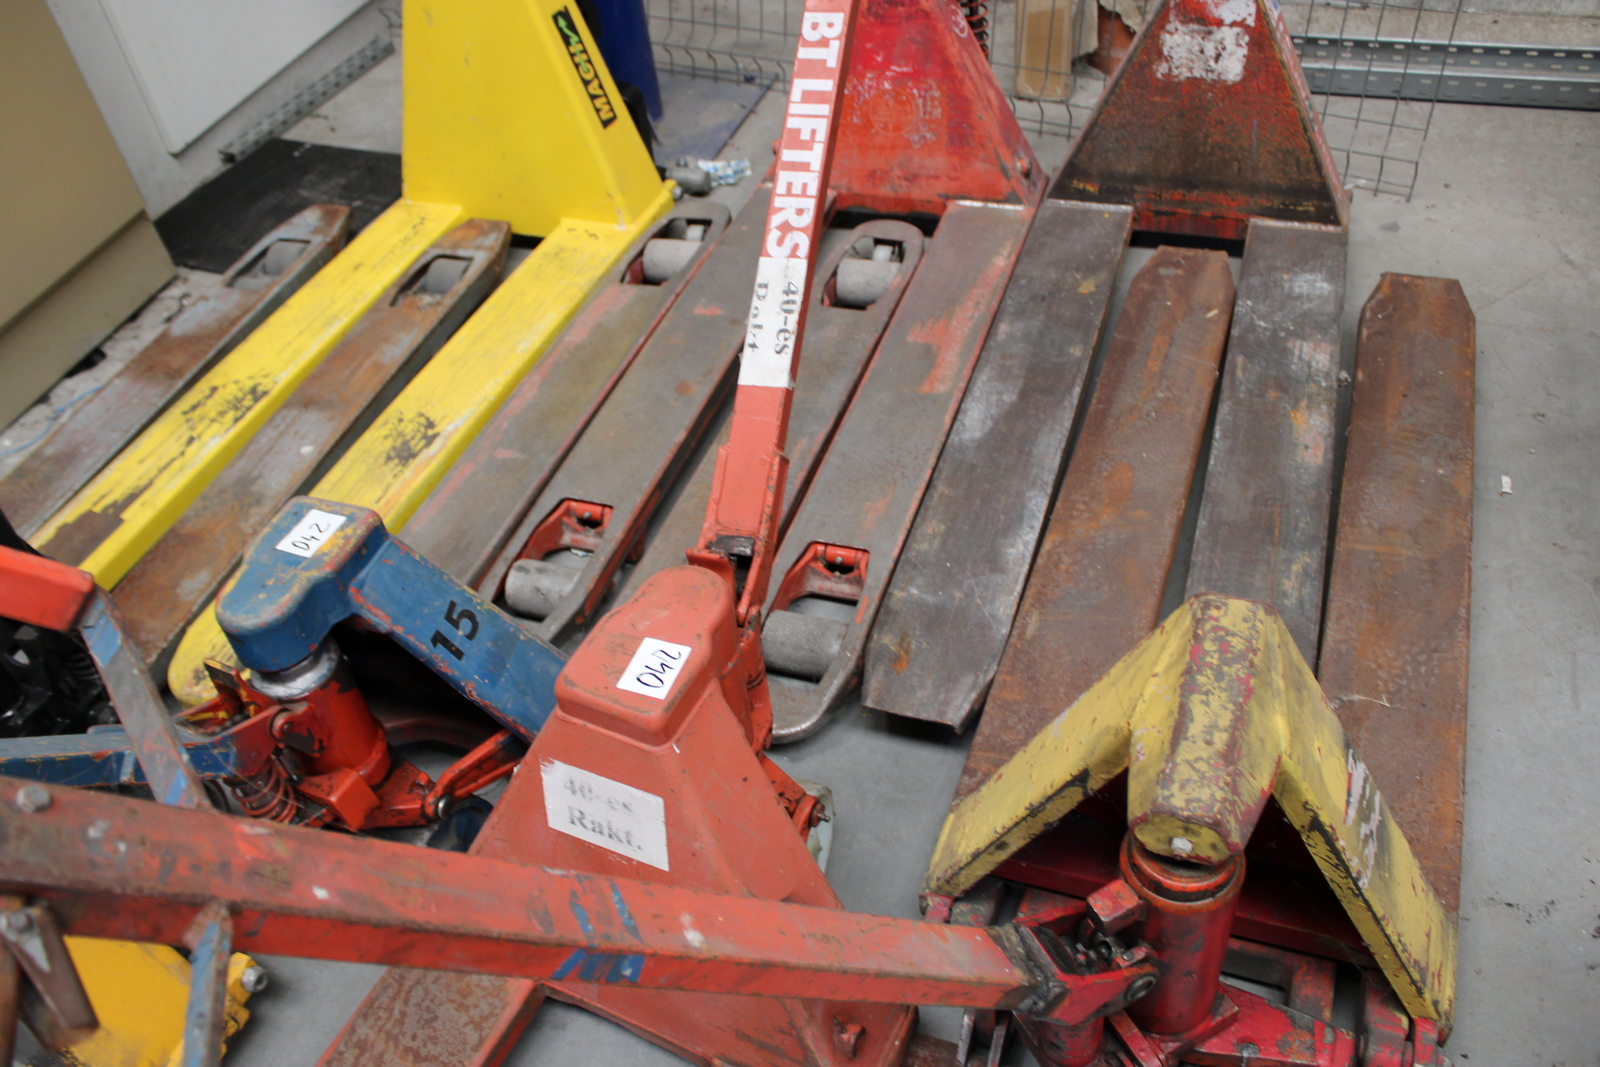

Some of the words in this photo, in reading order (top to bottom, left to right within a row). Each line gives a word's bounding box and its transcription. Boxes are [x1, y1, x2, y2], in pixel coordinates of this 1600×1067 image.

[797, 11, 845, 68] BT
[568, 42, 615, 120] MACH
[766, 79, 834, 259] LIFTERS
[292, 523, 331, 551] 042
[430, 600, 479, 661] 15
[636, 649, 682, 688] 042
